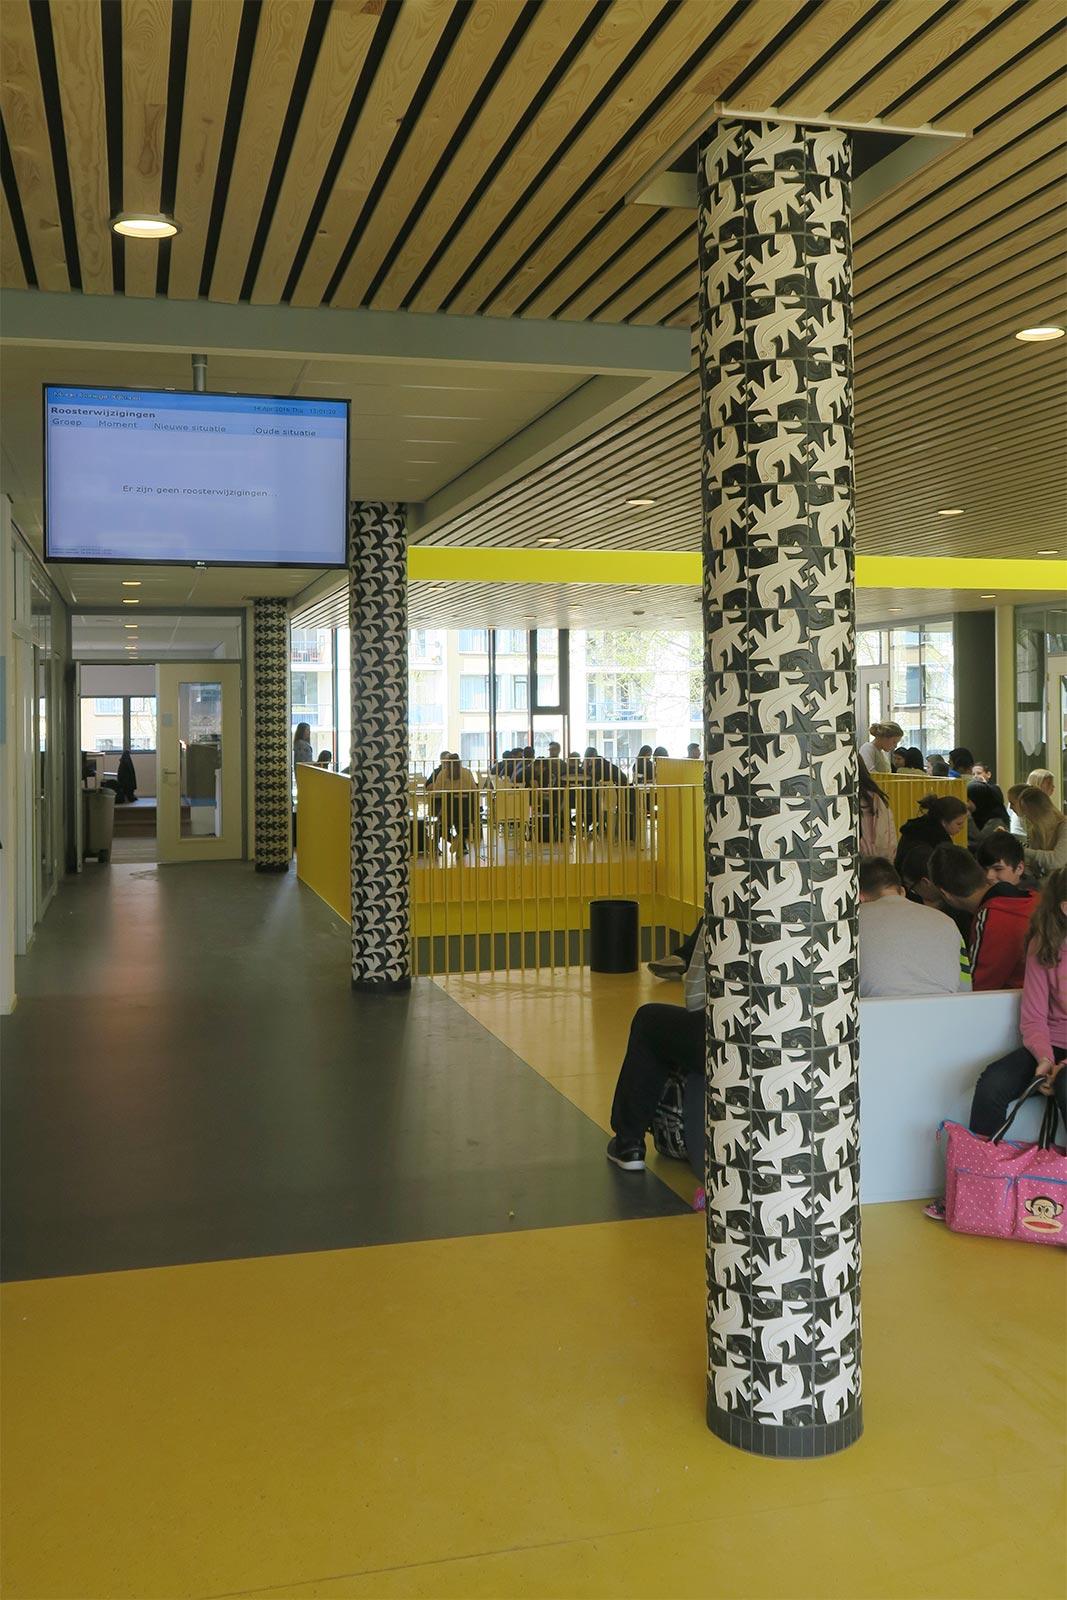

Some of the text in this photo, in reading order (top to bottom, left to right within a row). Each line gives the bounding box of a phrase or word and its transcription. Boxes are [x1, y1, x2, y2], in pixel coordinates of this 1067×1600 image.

[51, 407, 156, 418] Roosterwijzigingen
[52, 418, 82, 427] Groep
[98, 420, 137, 428] Moment
[153, 422, 226, 432] Nieuwe situatie
[282, 428, 316, 437] situatie
[136, 485, 153, 494] zijn
[156, 486, 179, 494] geen
